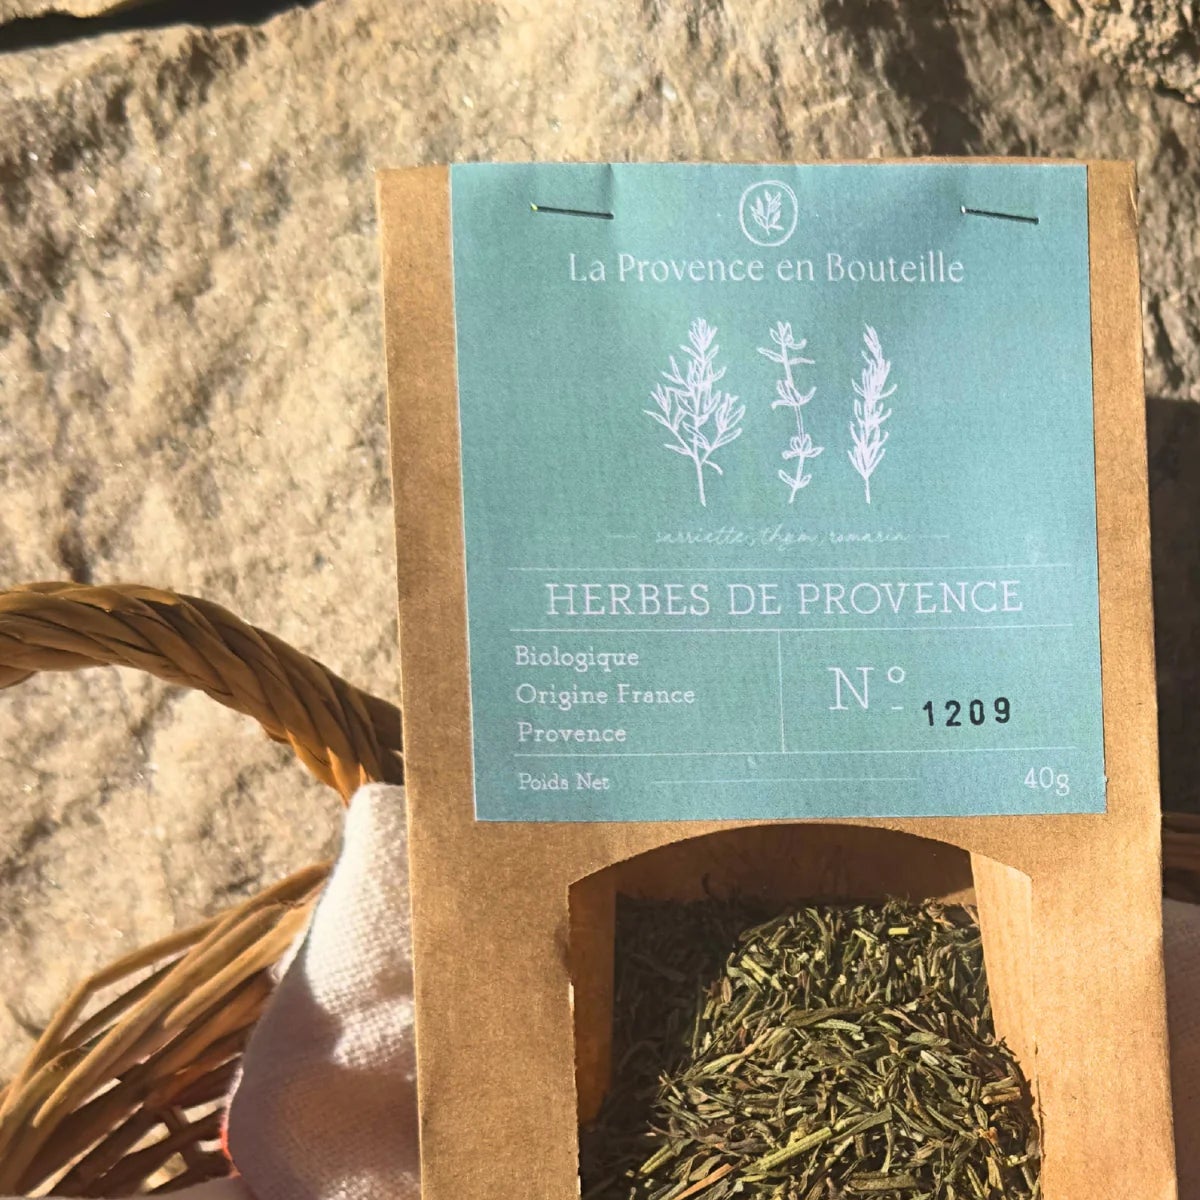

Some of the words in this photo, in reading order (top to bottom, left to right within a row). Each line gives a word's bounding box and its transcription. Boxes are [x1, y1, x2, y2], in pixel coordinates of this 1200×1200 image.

[570, 253, 606, 282] La
[618, 253, 764, 282] Provence
[778, 260, 814, 282] en
[827, 250, 965, 282] Bouteille
[546, 582, 711, 616] HERBES
[728, 583, 781, 615] DE
[798, 580, 1023, 615] PROVENCE
[515, 646, 639, 669] Biologique
[515, 684, 608, 710] Origine
[617, 684, 695, 705] France
[922, 697, 1012, 727] 1209
[518, 723, 627, 743] Provence
[518, 773, 569, 791] Poids
[576, 773, 610, 791] Net
[1023, 766, 1071, 796] 40g
